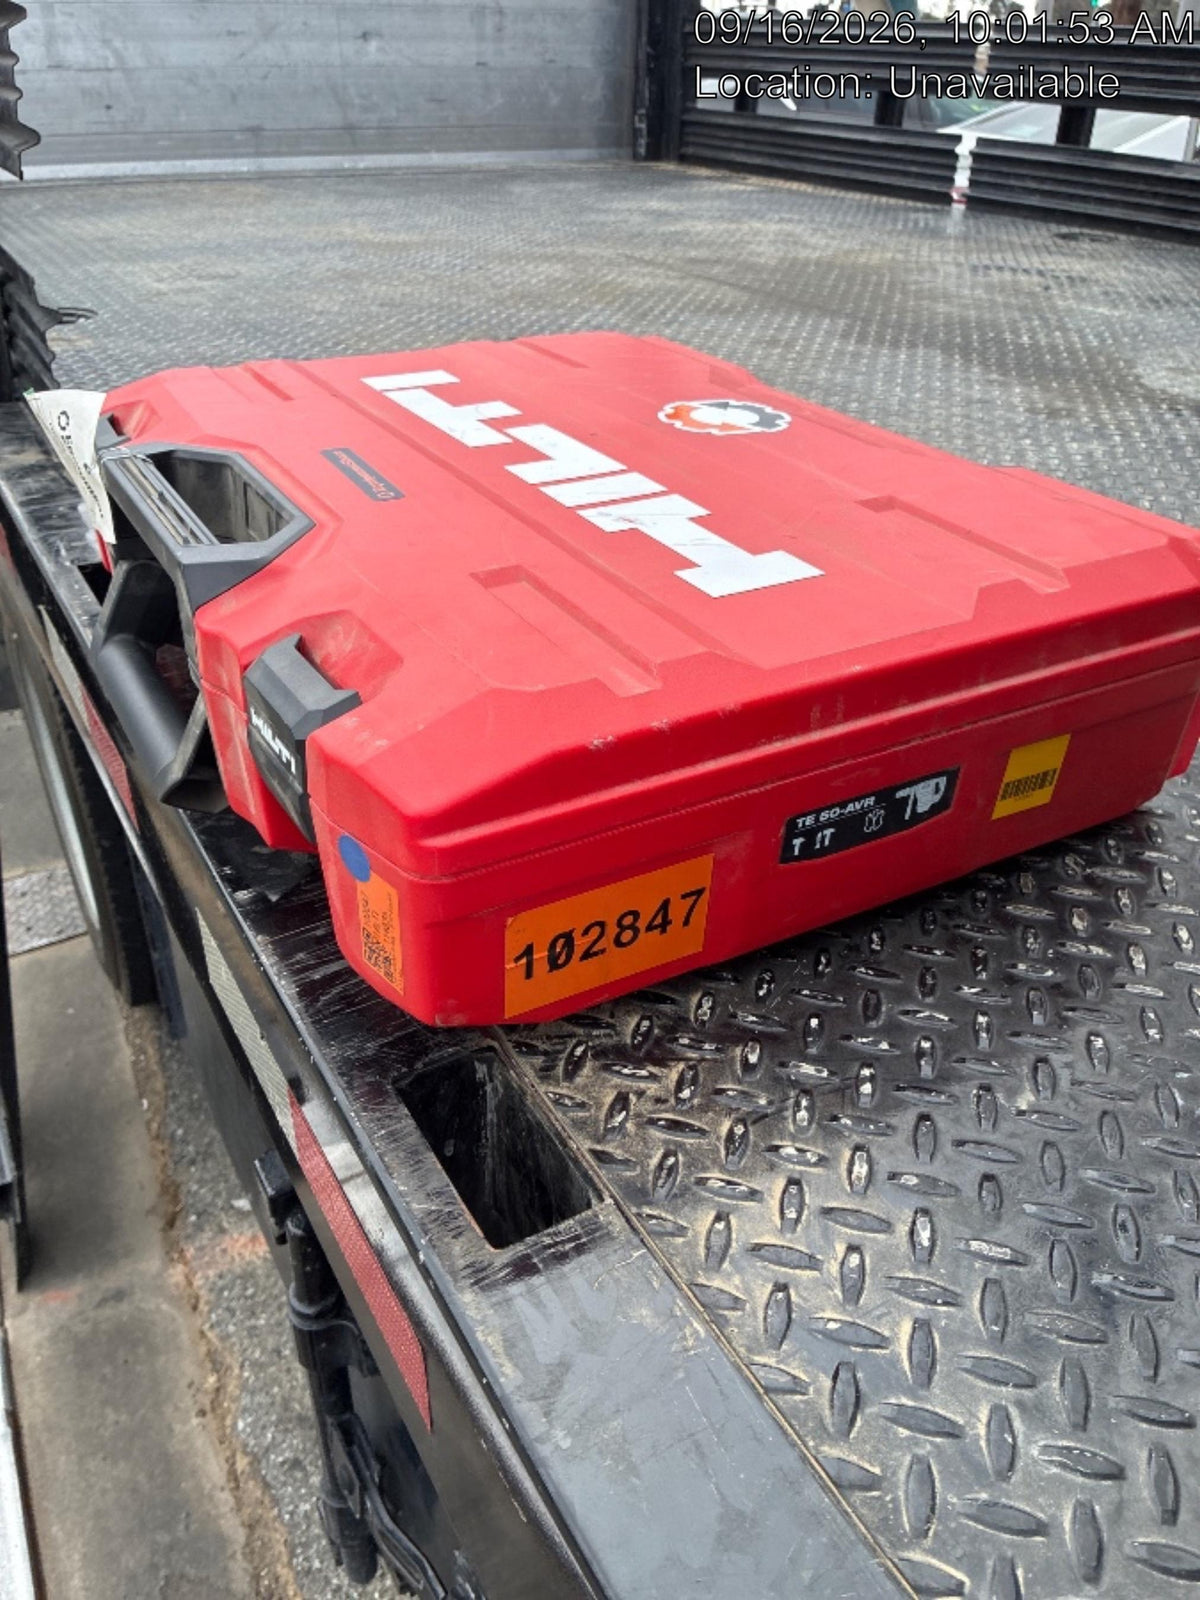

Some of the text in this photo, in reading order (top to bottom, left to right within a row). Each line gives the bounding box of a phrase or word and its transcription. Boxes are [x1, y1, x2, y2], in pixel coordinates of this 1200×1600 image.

[360, 369, 825, 598] HILTI
[249, 706, 296, 775] HILTI
[796, 814, 816, 828] TE
[513, 887, 706, 980] 102847
